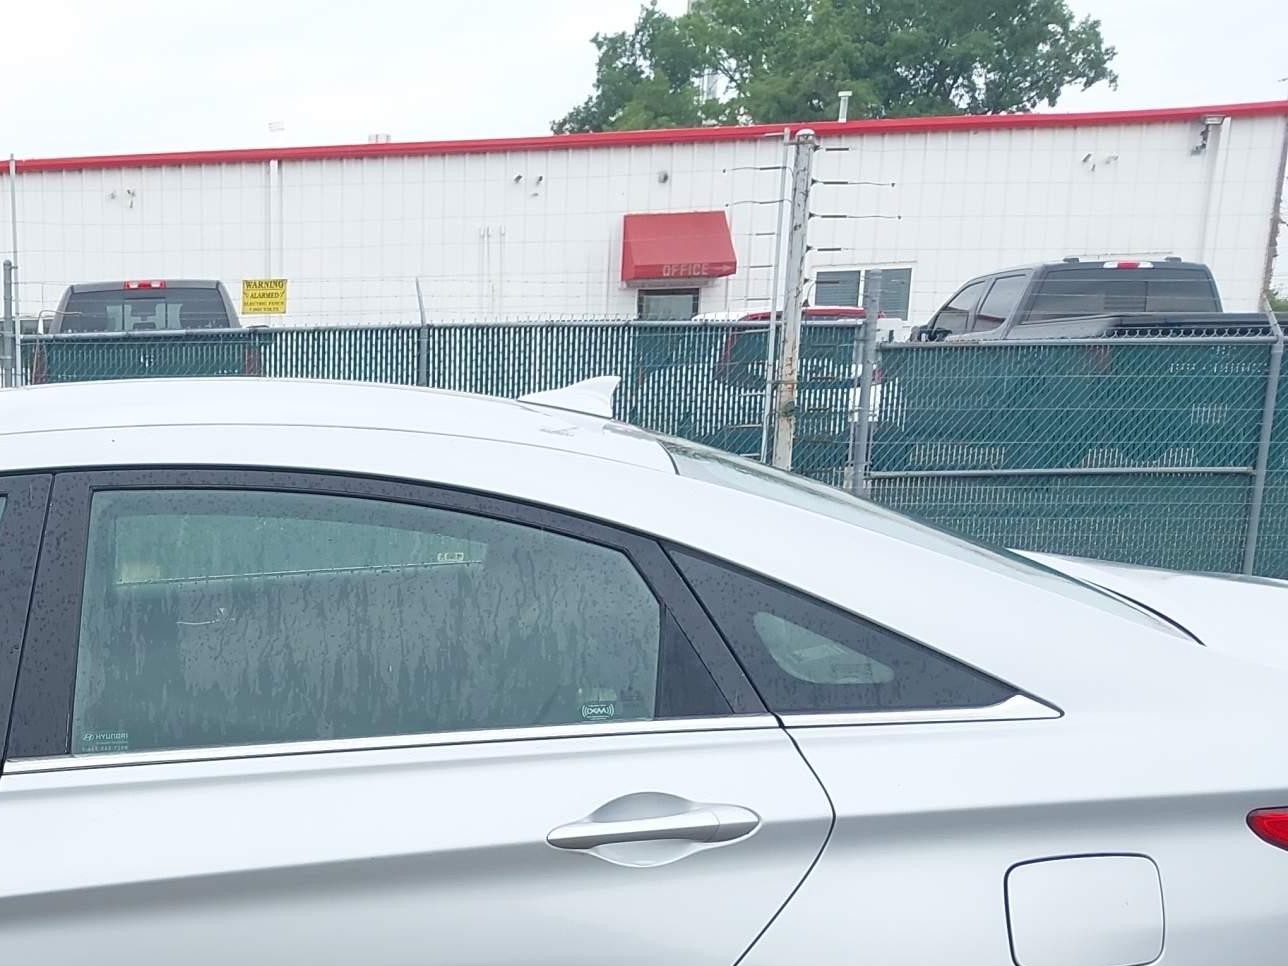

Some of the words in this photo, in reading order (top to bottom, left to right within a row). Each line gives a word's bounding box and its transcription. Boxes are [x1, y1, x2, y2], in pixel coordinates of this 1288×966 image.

[662, 263, 709, 277] OFFICE
[246, 280, 284, 289] WARNING
[95, 732, 129, 740] HYUNDAI
